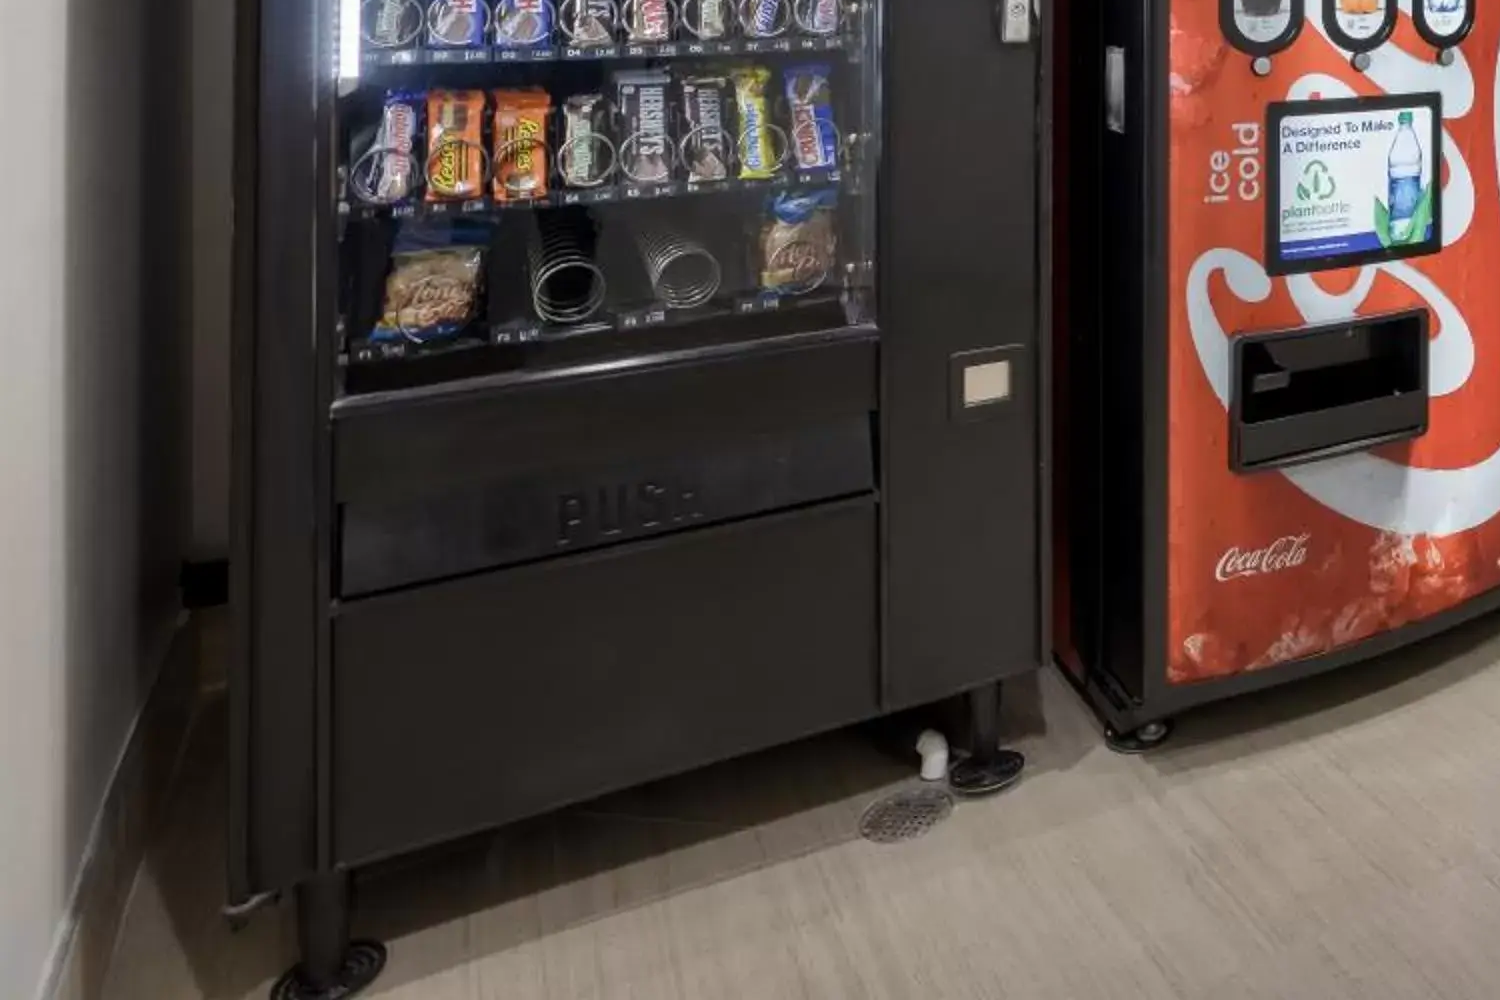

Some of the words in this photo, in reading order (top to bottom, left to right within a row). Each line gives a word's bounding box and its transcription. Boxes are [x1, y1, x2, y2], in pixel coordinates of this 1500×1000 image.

[1281, 123, 1342, 140] Designed
[1344, 122, 1360, 134] To
[1361, 119, 1395, 133] Make
[1283, 144, 1293, 155] A
[1295, 138, 1361, 154] Difference
[1203, 150, 1231, 205] ice
[1231, 122, 1260, 202] cold
[1215, 533, 1312, 582] Coca-Cola
